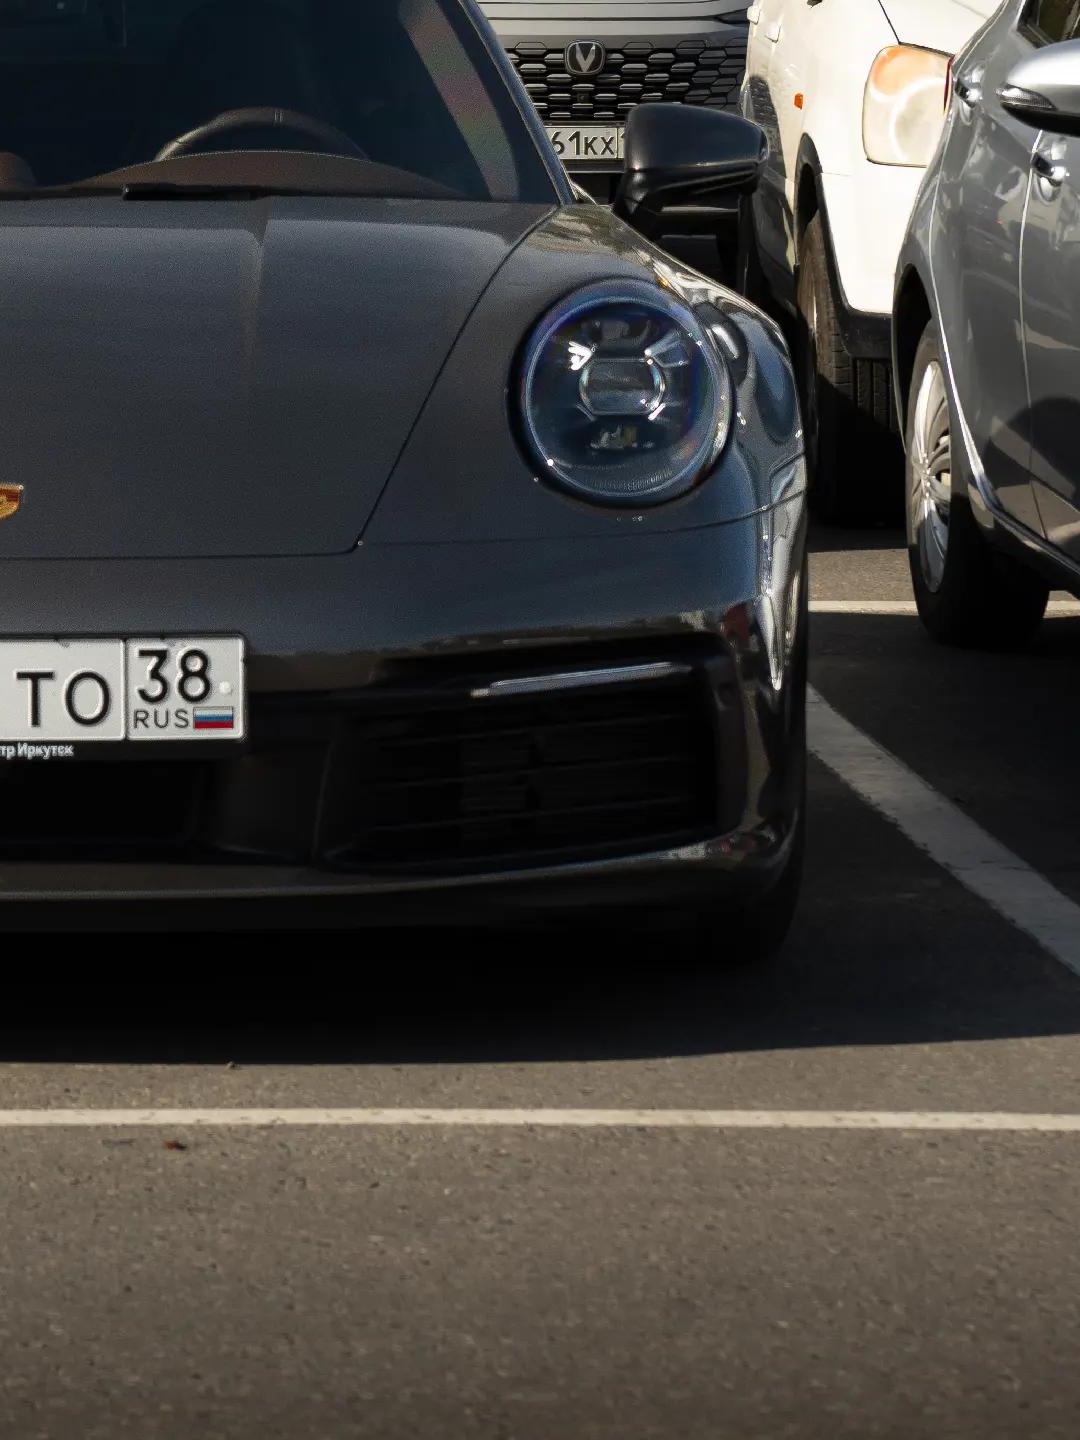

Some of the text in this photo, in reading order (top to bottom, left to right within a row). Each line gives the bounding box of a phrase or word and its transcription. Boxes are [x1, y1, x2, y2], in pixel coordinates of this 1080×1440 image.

[137, 649, 211, 703] 38
[133, 708, 190, 729] RUS
[17, 742, 74, 760] Иркутск
